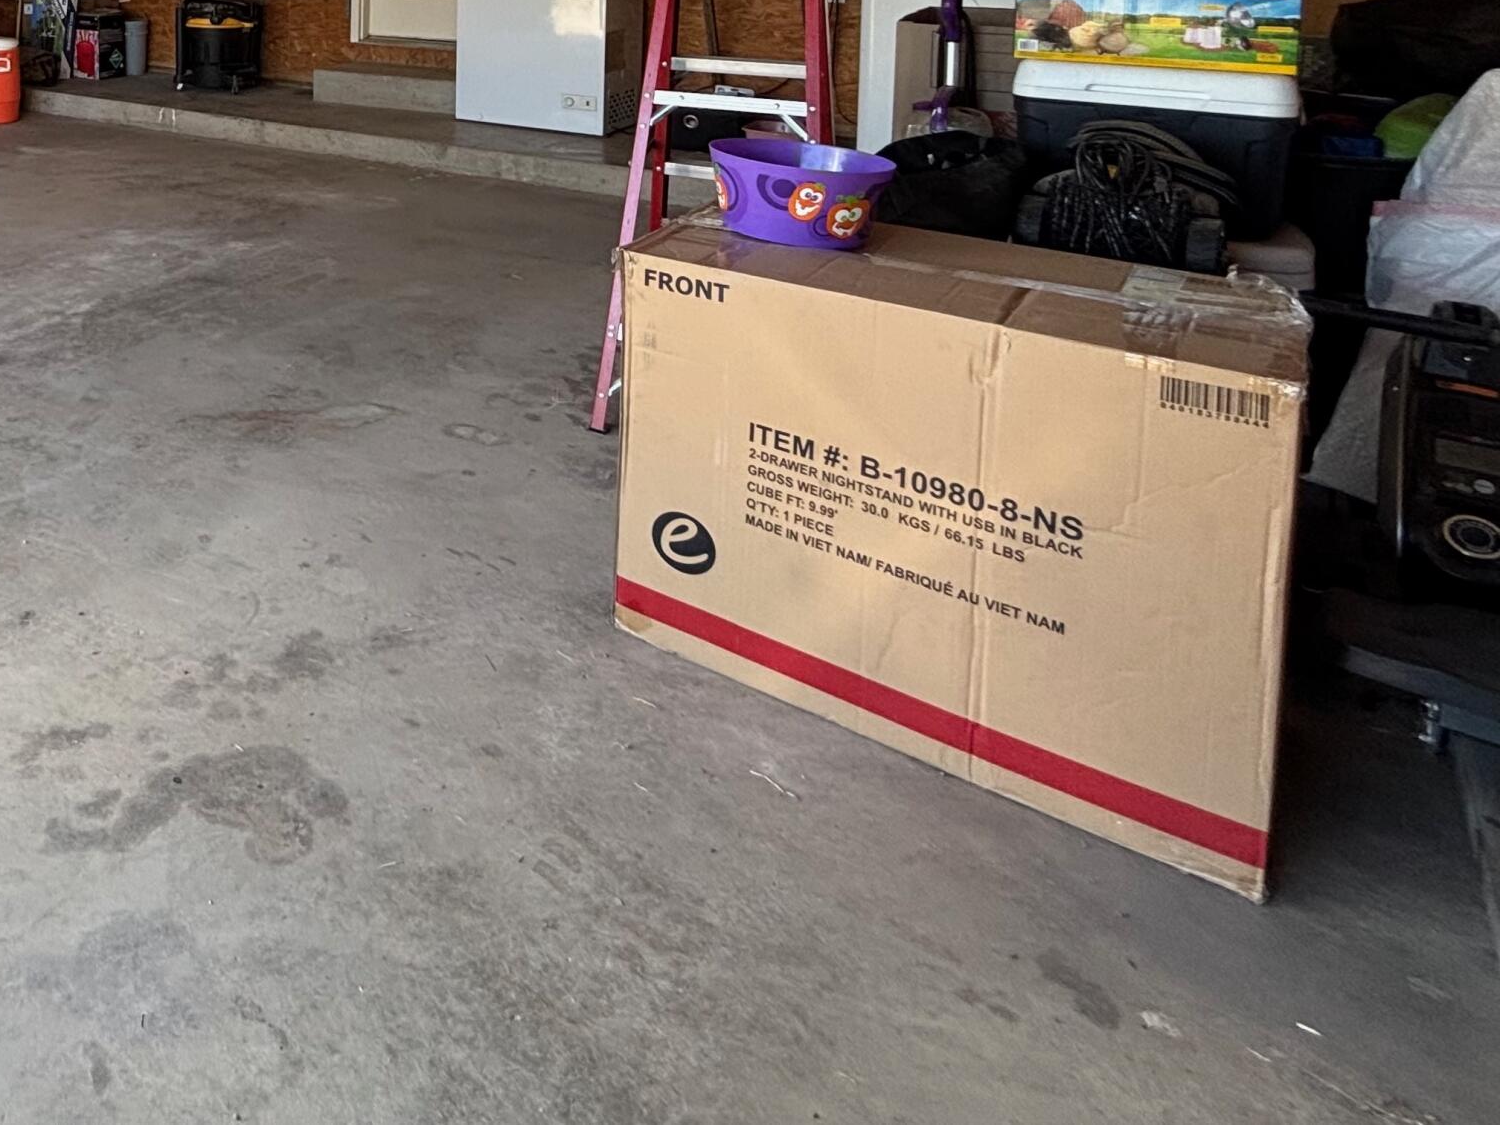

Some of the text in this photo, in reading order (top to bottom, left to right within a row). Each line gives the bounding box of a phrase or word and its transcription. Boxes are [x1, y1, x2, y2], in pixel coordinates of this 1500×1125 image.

[644, 268, 730, 303] FRONT
[746, 498, 835, 537] Q'TY: 1 PIECE
[747, 481, 783, 502] CUBE
[786, 494, 805, 510] FT:
[747, 464, 794, 489] GROSS
[797, 479, 854, 509] WEIGHT:
[861, 501, 889, 519] 30.0
[898, 512, 931, 534] KGS
[944, 528, 984, 551] 66.15
[992, 542, 1026, 563] LBS
[749, 422, 1084, 541] ITEM #: B-10980-8-NS
[749, 447, 1084, 559] 2-DRAWER NIGHTSTAND WITH USB IN BLACK
[745, 514, 1066, 636] MADE IN VIET NAM/ FABRIQUÉ AU VIET NAM
